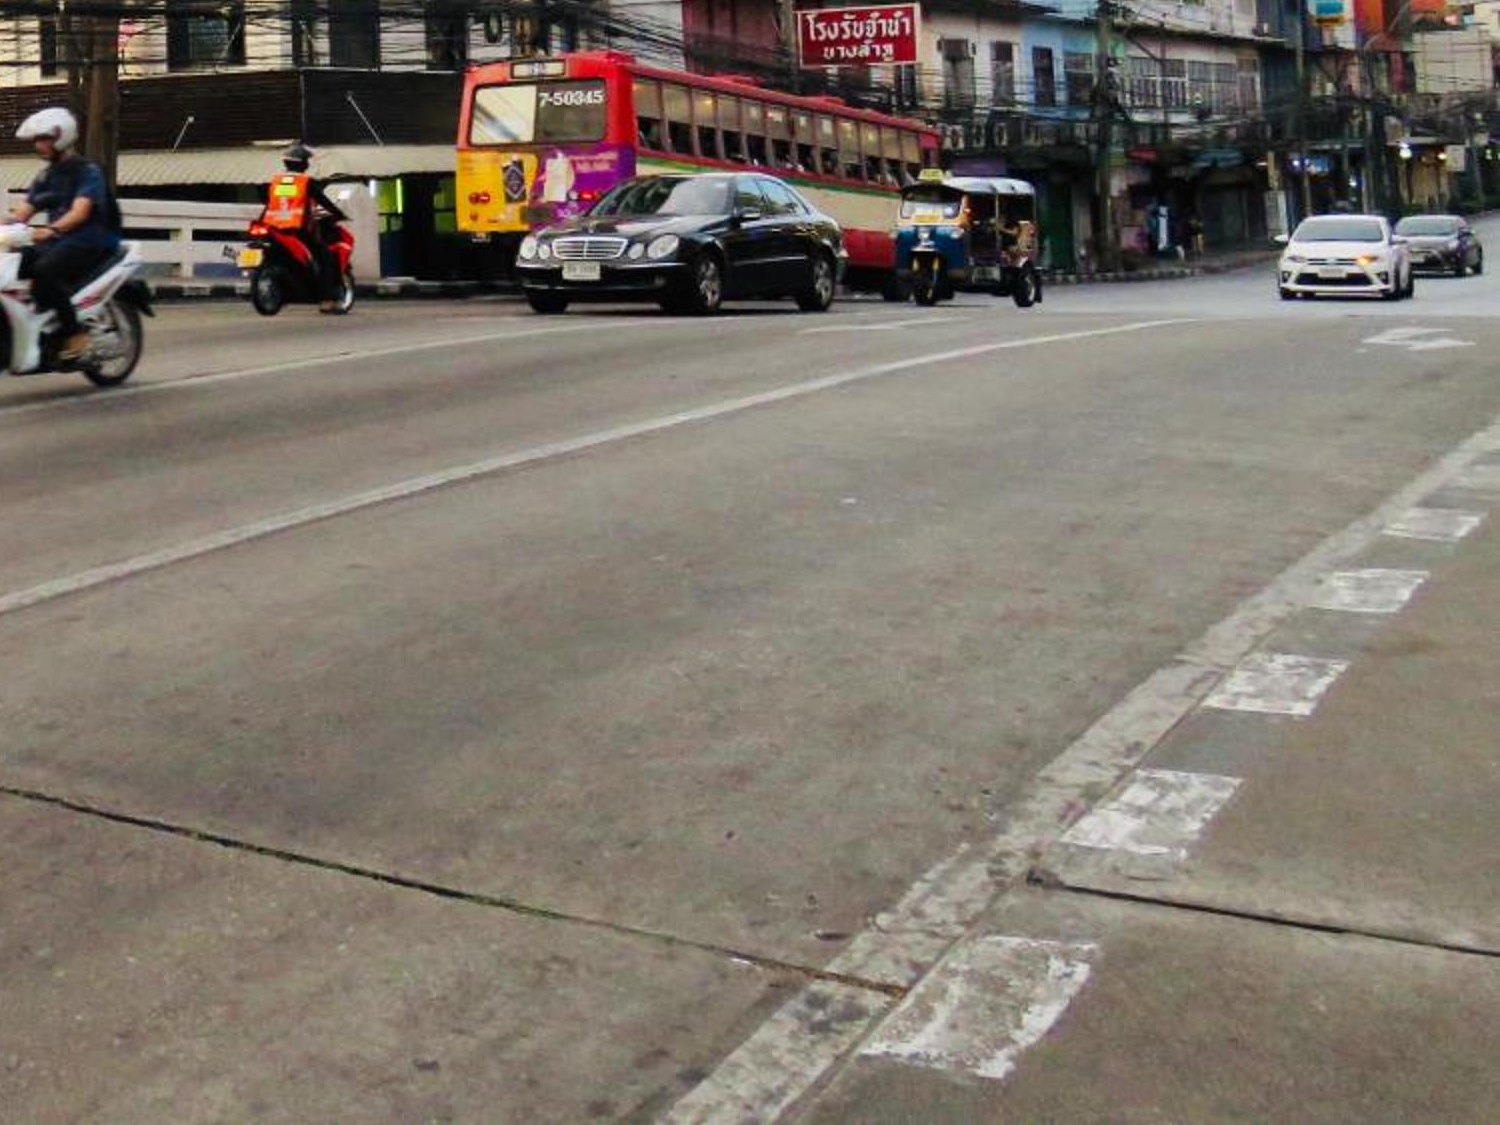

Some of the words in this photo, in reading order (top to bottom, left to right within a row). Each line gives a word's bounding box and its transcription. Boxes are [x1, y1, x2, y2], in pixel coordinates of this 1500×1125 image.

[806, 11, 911, 41] โรงรับจำนำ
[539, 90, 605, 108] 7-50345
